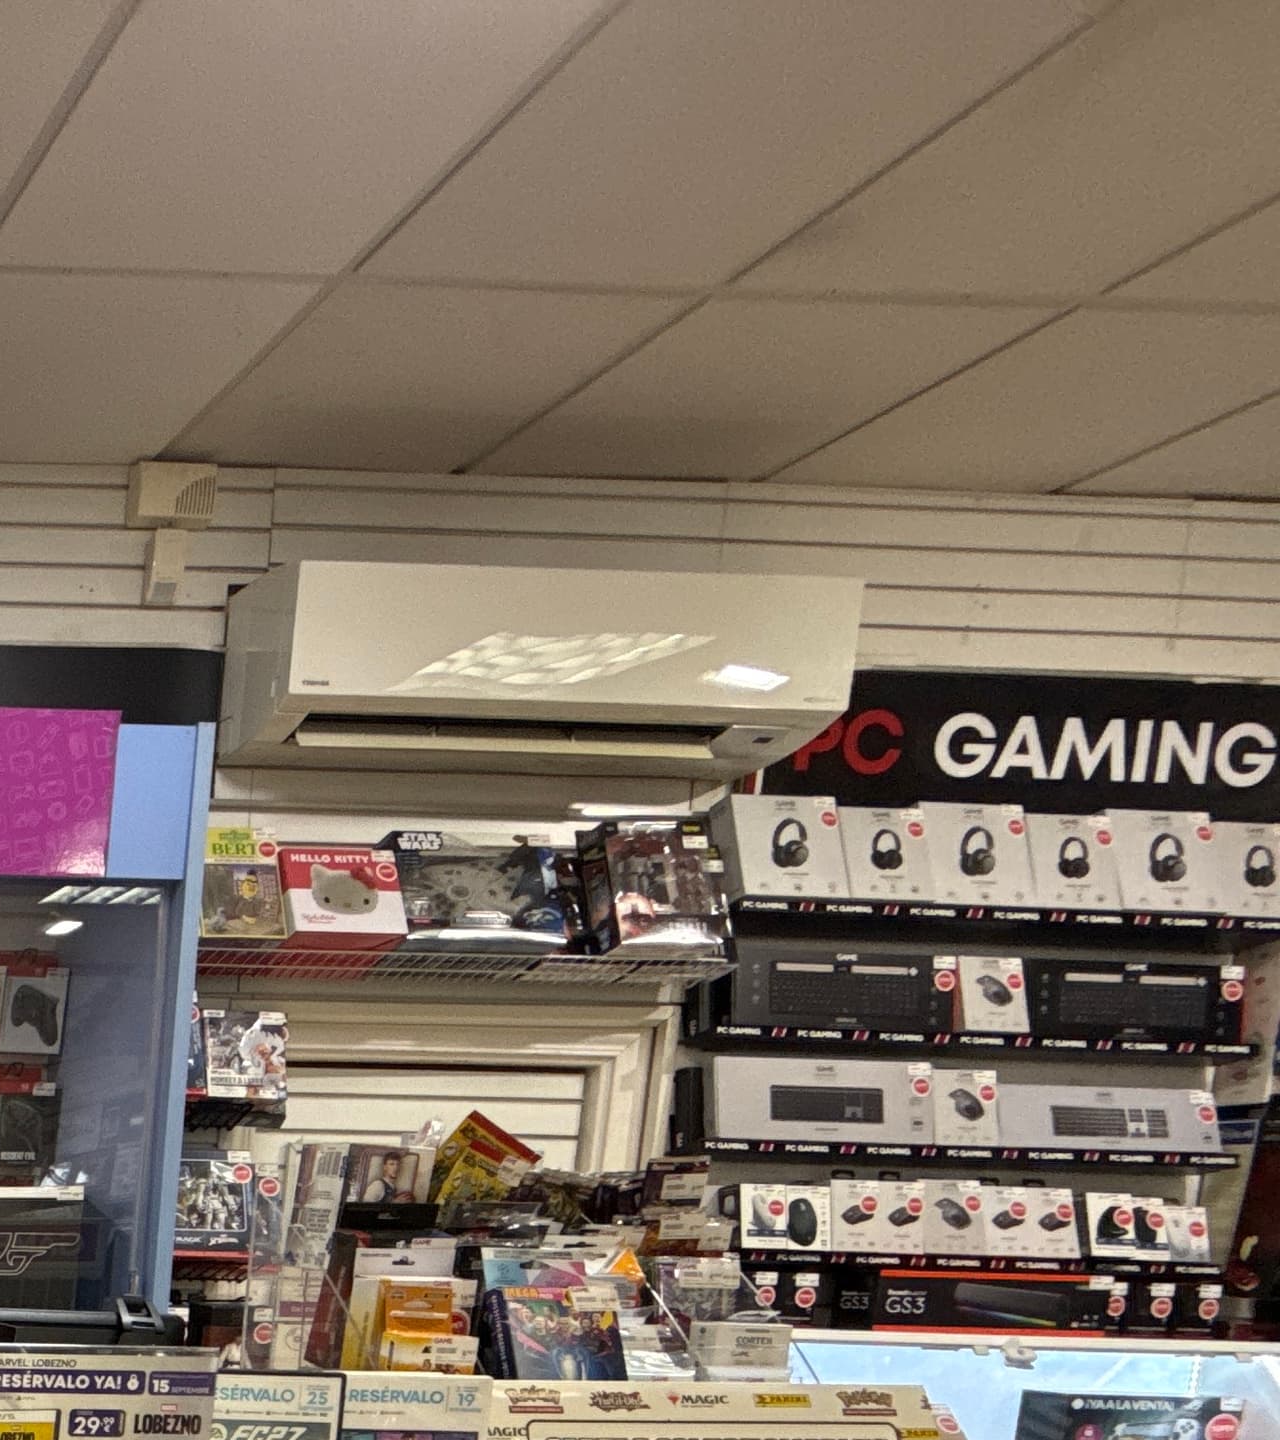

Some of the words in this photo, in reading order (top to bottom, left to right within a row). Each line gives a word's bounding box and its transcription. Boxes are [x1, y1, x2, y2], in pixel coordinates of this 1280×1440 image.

[793, 709, 905, 774] PC
[934, 712, 1277, 787] GAMING
[398, 832, 440, 842] STAR
[212, 843, 255, 855] BERT
[398, 840, 440, 850] WARS
[291, 854, 327, 863] HELLO
[331, 855, 368, 863] KITTY
[885, 1296, 925, 1314] GS3
[31, 1359, 76, 1368] LOBEZNO
[95, 1376, 121, 1390] YA!
[153, 1380, 170, 1392] 15
[309, 1393, 327, 1404] 25
[349, 1388, 444, 1403] RESÉRVALO
[458, 1394, 474, 1406] 19
[681, 1394, 728, 1405] MAGIC
[134, 1415, 201, 1434] LOBEZNO
